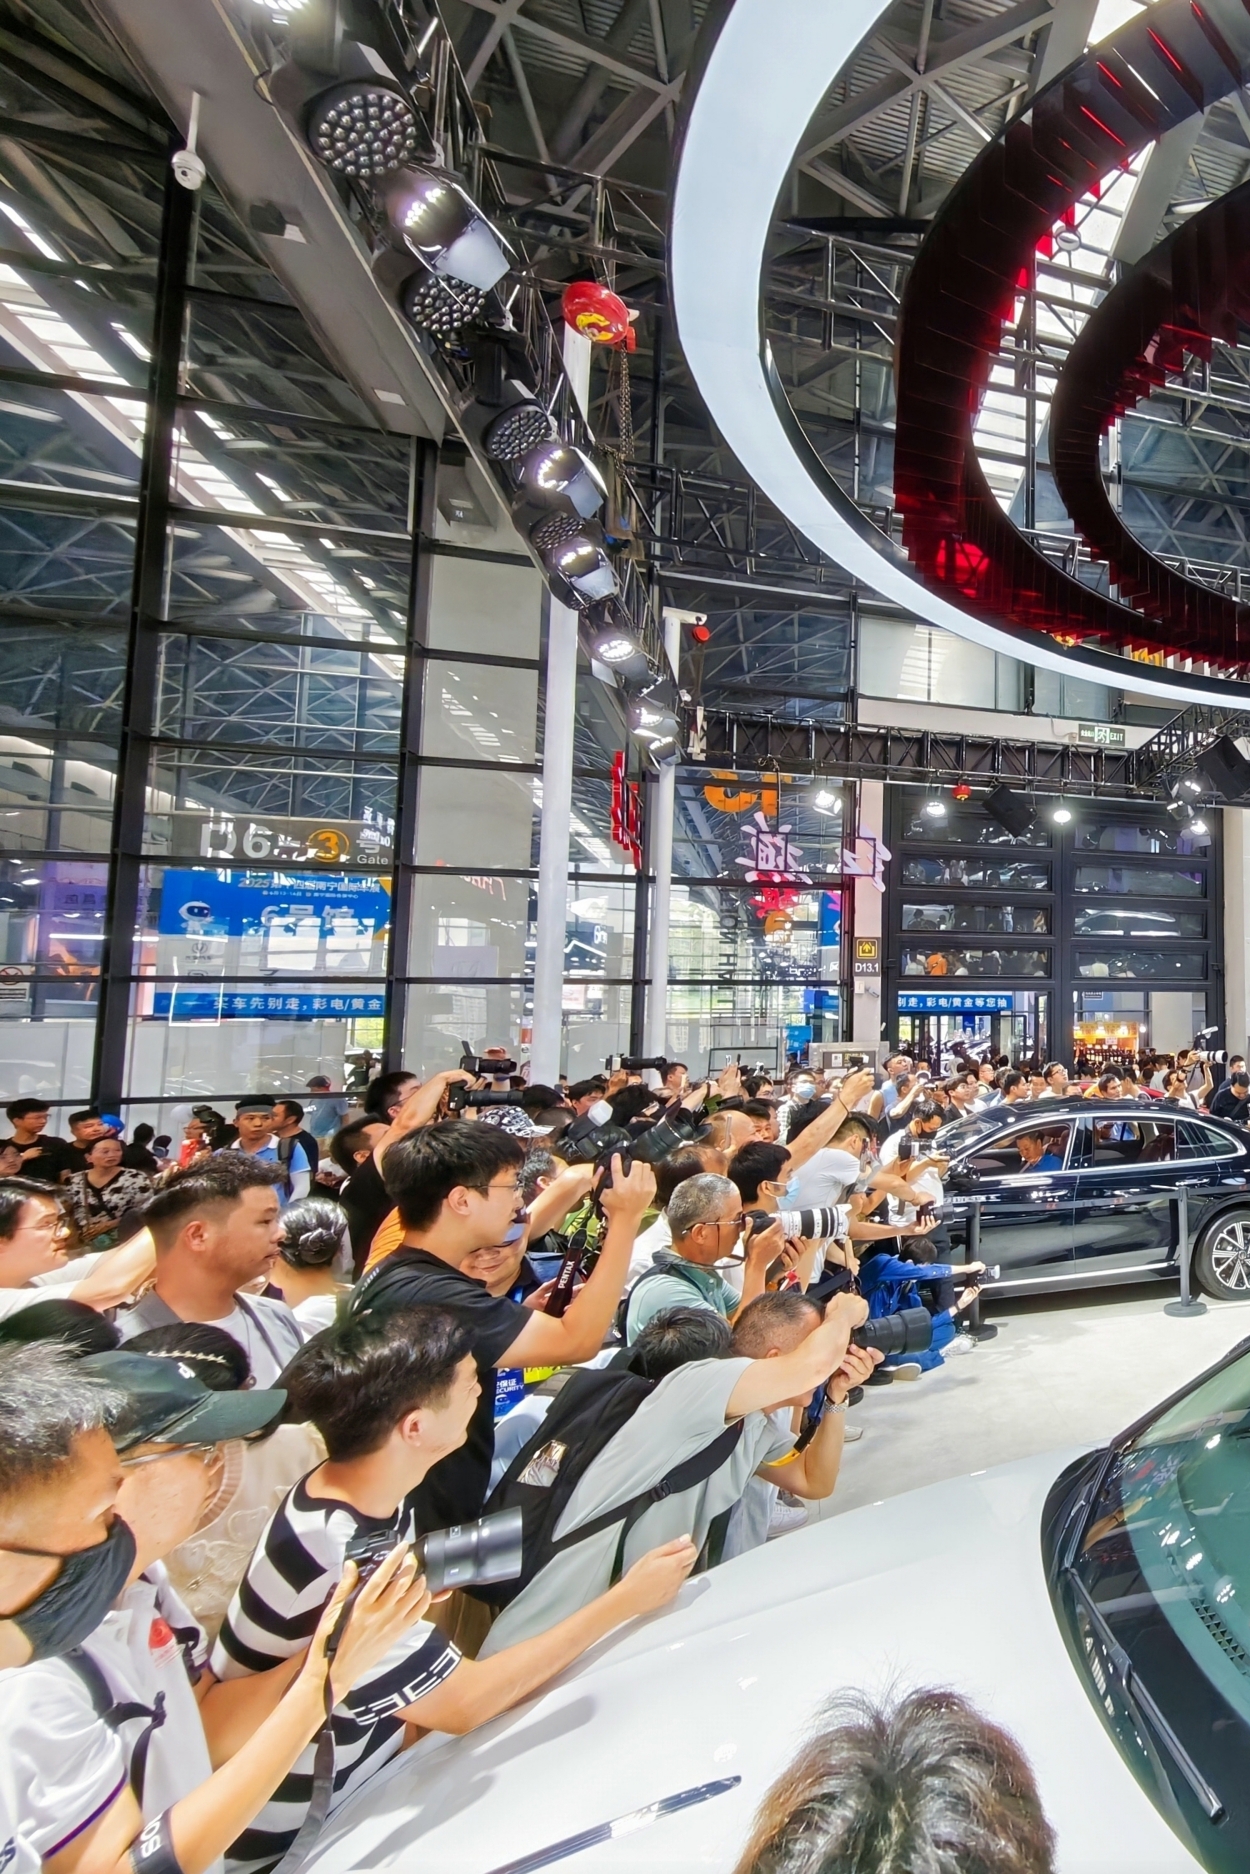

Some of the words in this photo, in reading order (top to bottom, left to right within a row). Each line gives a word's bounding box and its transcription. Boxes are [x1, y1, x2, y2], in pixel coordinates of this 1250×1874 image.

[356, 854, 389, 866] Gate
[854, 962, 879, 973] D13.1
[558, 1261, 575, 1289] PENTAX
